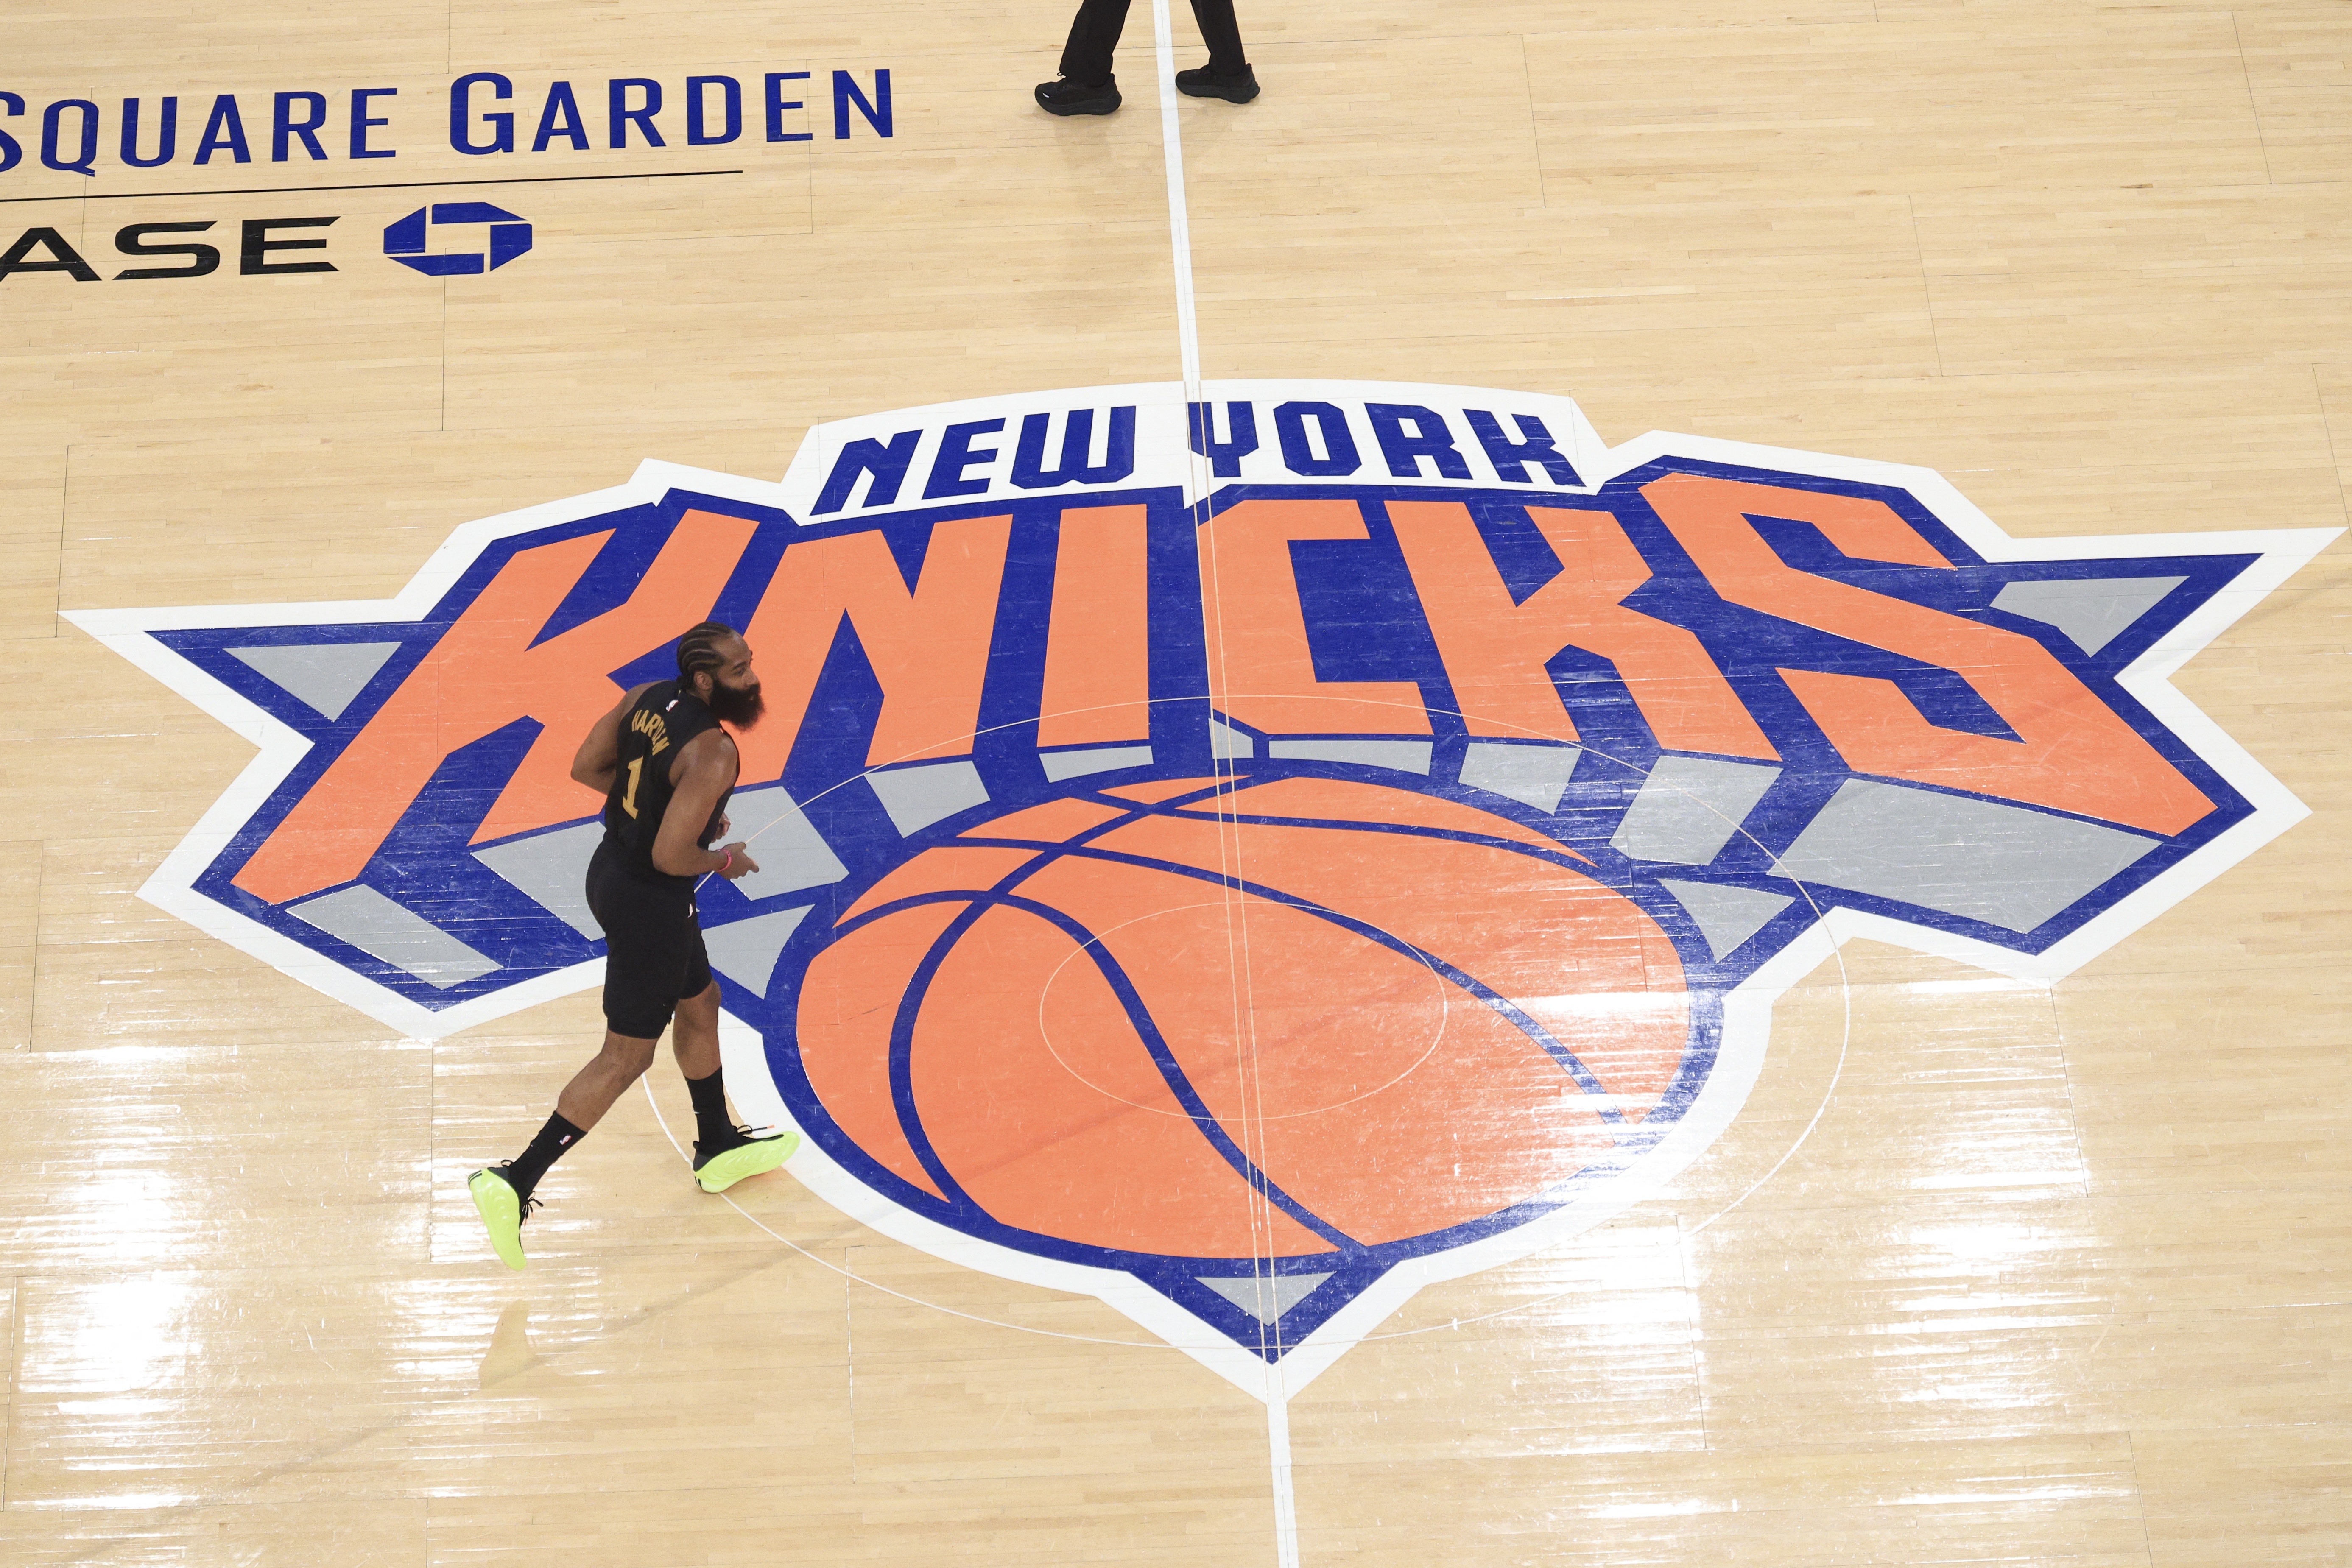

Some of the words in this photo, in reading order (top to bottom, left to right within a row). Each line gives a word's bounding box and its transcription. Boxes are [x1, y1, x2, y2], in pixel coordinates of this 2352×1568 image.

[809, 405, 1136, 516] NEW
[1188, 400, 1586, 487] YORK
[230, 472, 2218, 905] KNICKS
[631, 709, 670, 756] HARDEN
[622, 756, 643, 820] 1
